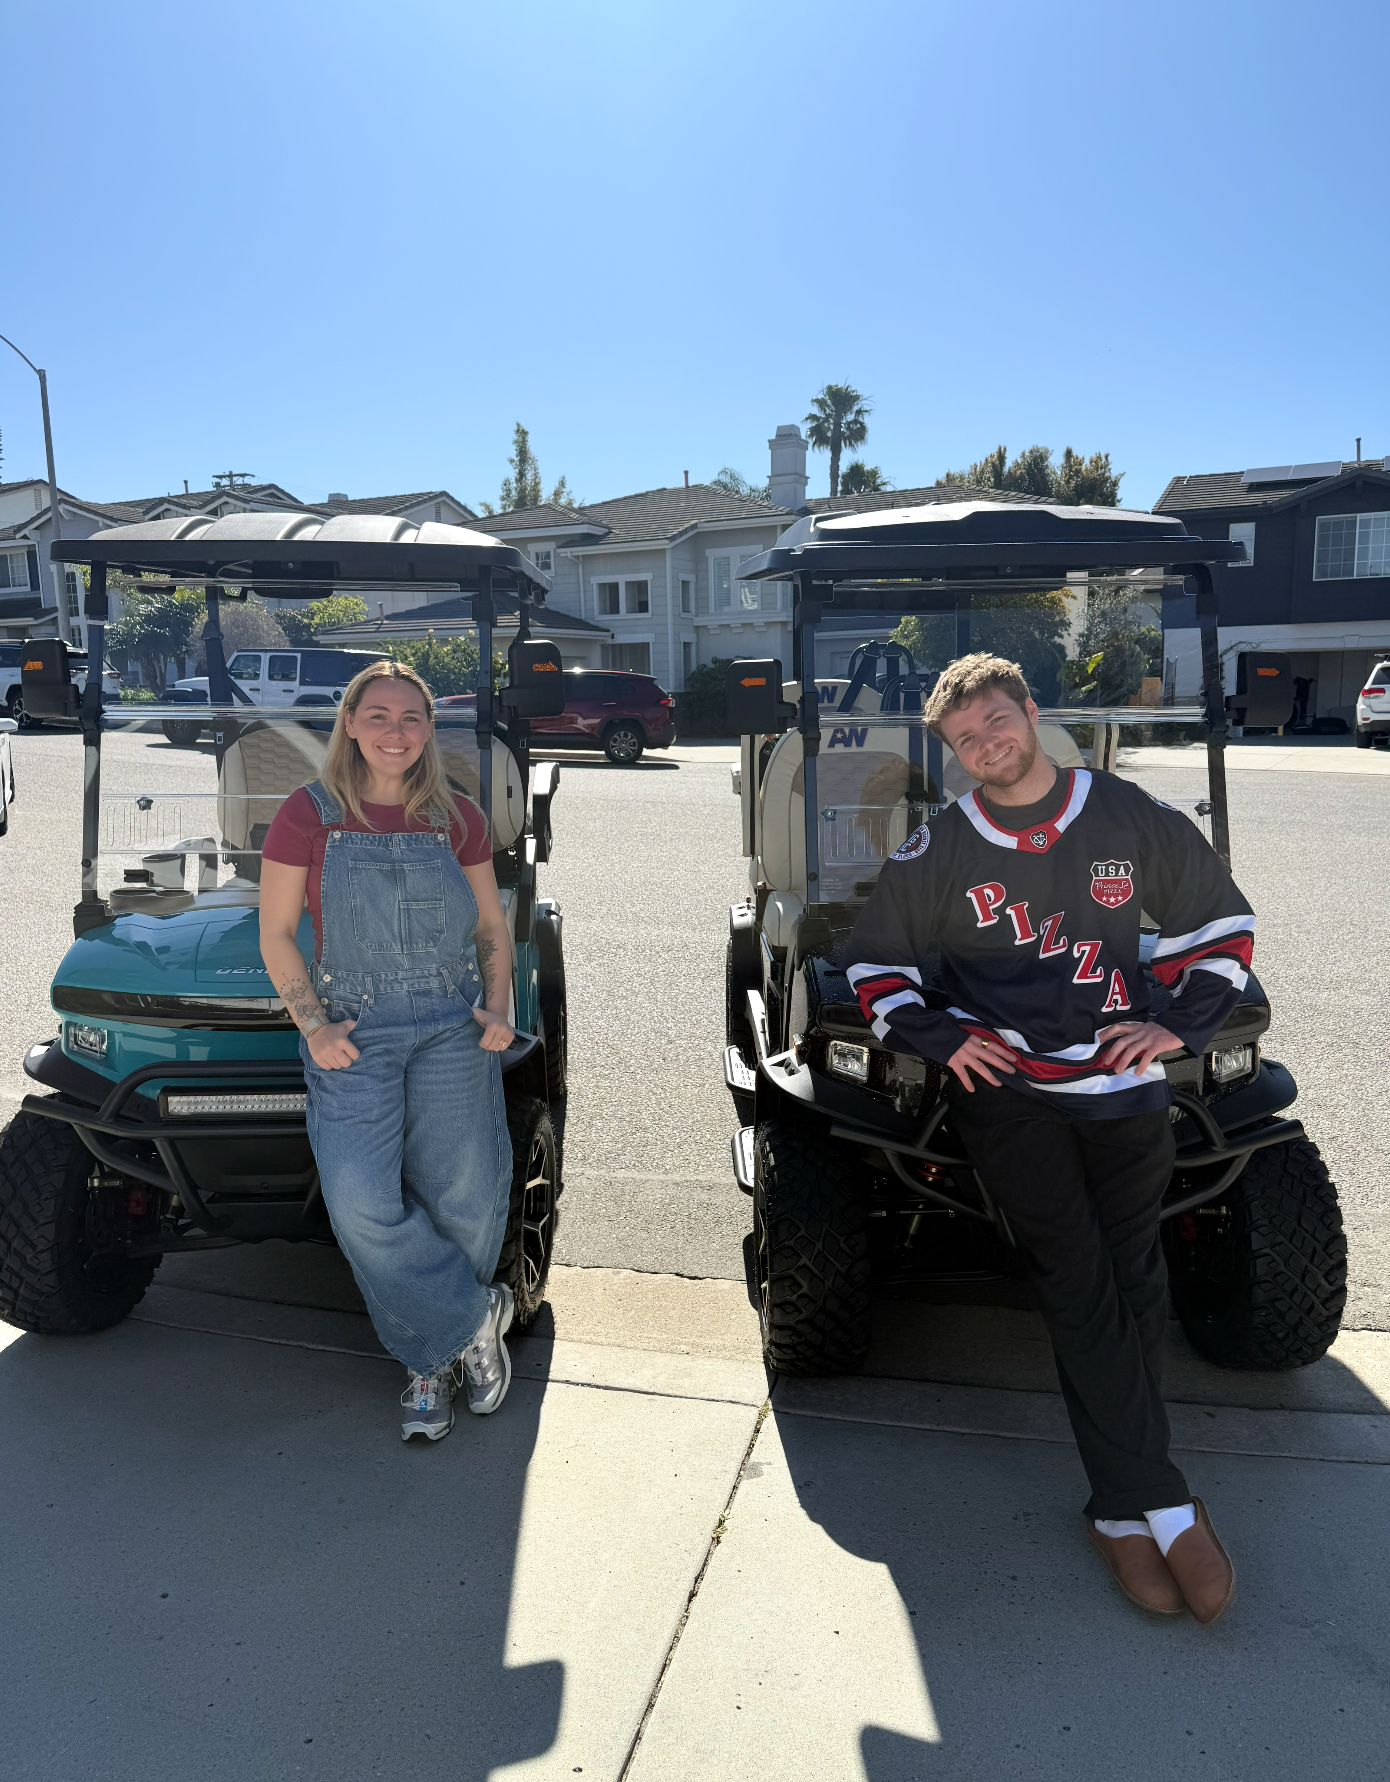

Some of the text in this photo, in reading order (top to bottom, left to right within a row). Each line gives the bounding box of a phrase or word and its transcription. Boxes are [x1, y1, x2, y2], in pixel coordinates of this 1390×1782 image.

[1098, 865, 1126, 877] USA
[1095, 882, 1118, 891] Prince
[966, 881, 1132, 1013] PIZZA
[215, 966, 269, 975] DEN
